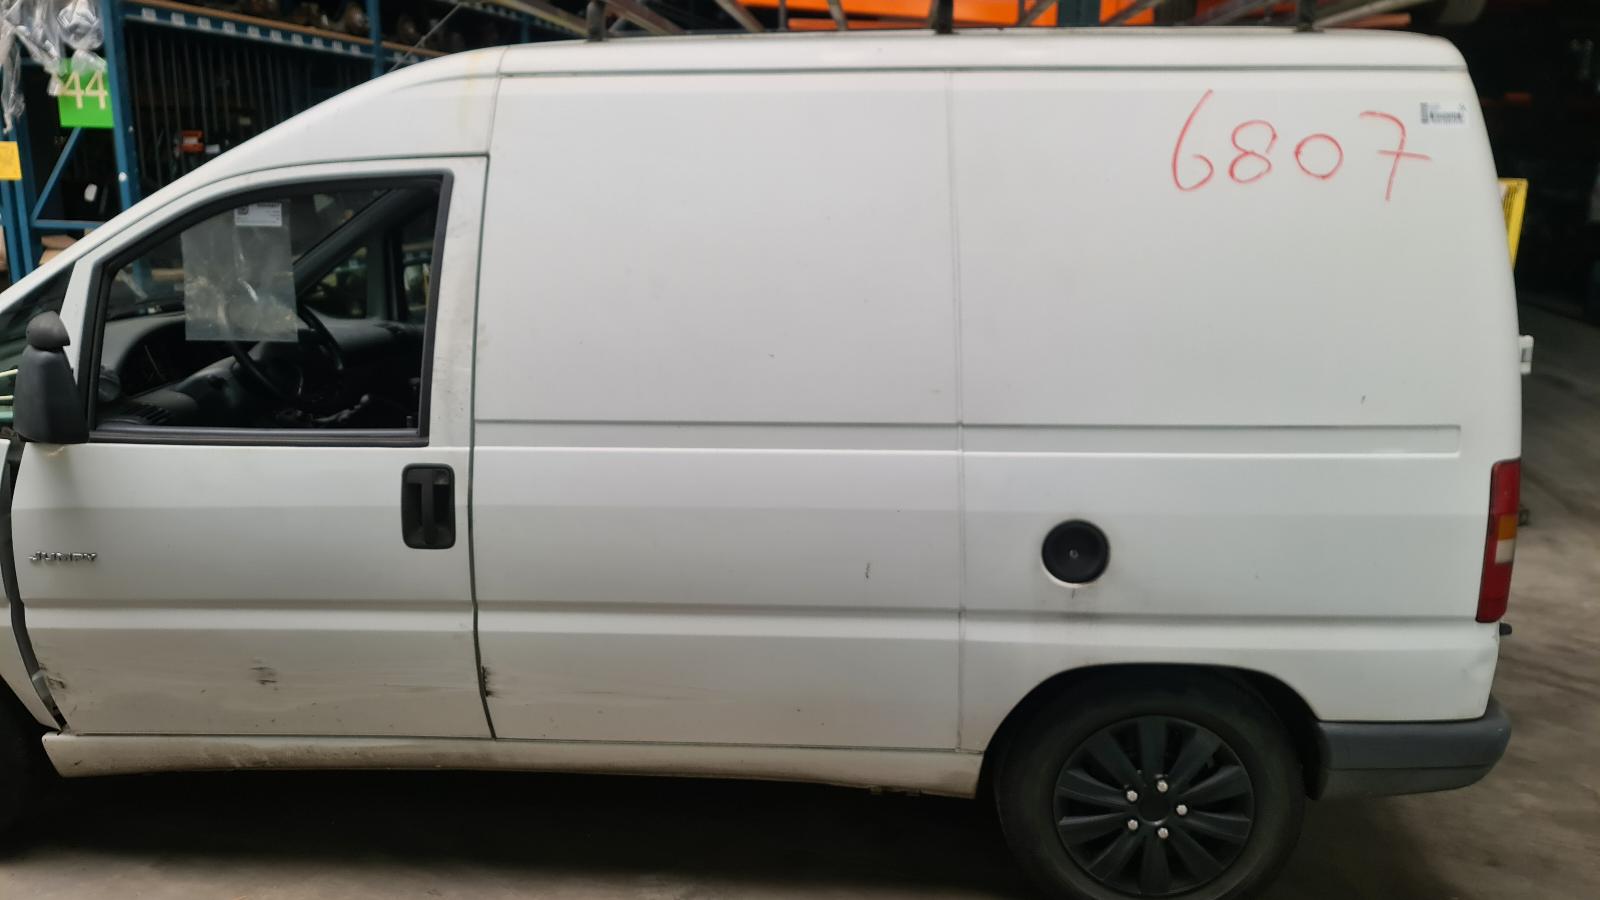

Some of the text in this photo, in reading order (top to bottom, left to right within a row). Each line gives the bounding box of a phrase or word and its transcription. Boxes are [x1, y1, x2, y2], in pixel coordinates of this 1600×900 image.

[59, 70, 109, 109] 44
[1172, 89, 1431, 202] 6807
[31, 551, 98, 562] JUMPY
